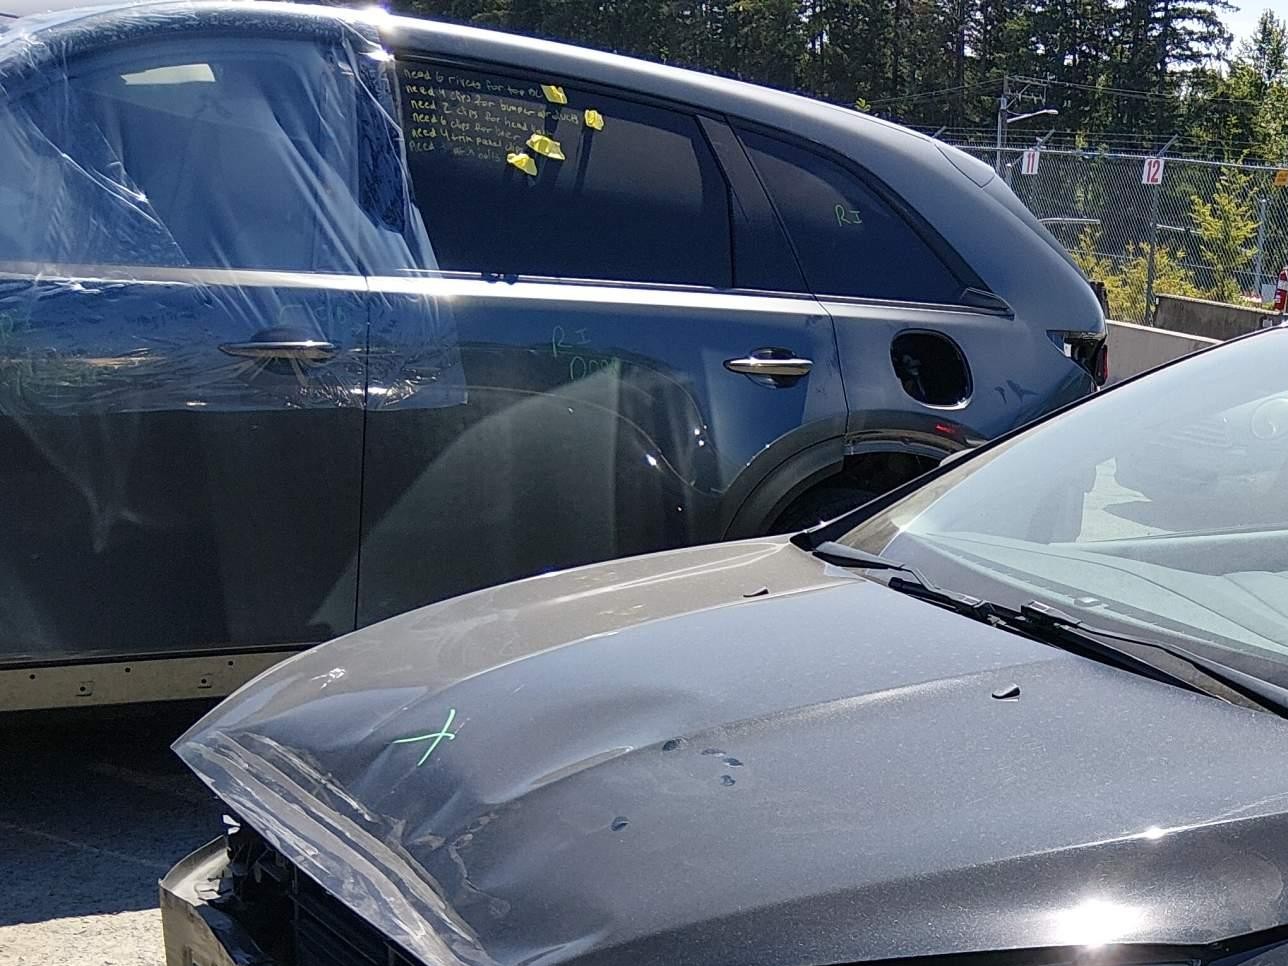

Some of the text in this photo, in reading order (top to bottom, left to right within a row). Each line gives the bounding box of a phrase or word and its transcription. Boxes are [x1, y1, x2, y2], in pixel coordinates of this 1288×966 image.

[406, 84, 436, 97] need
[486, 80, 504, 92] for
[411, 99, 436, 110] need
[412, 112, 438, 123] need
[1026, 152, 1036, 174] 11
[1146, 160, 1161, 183] 12
